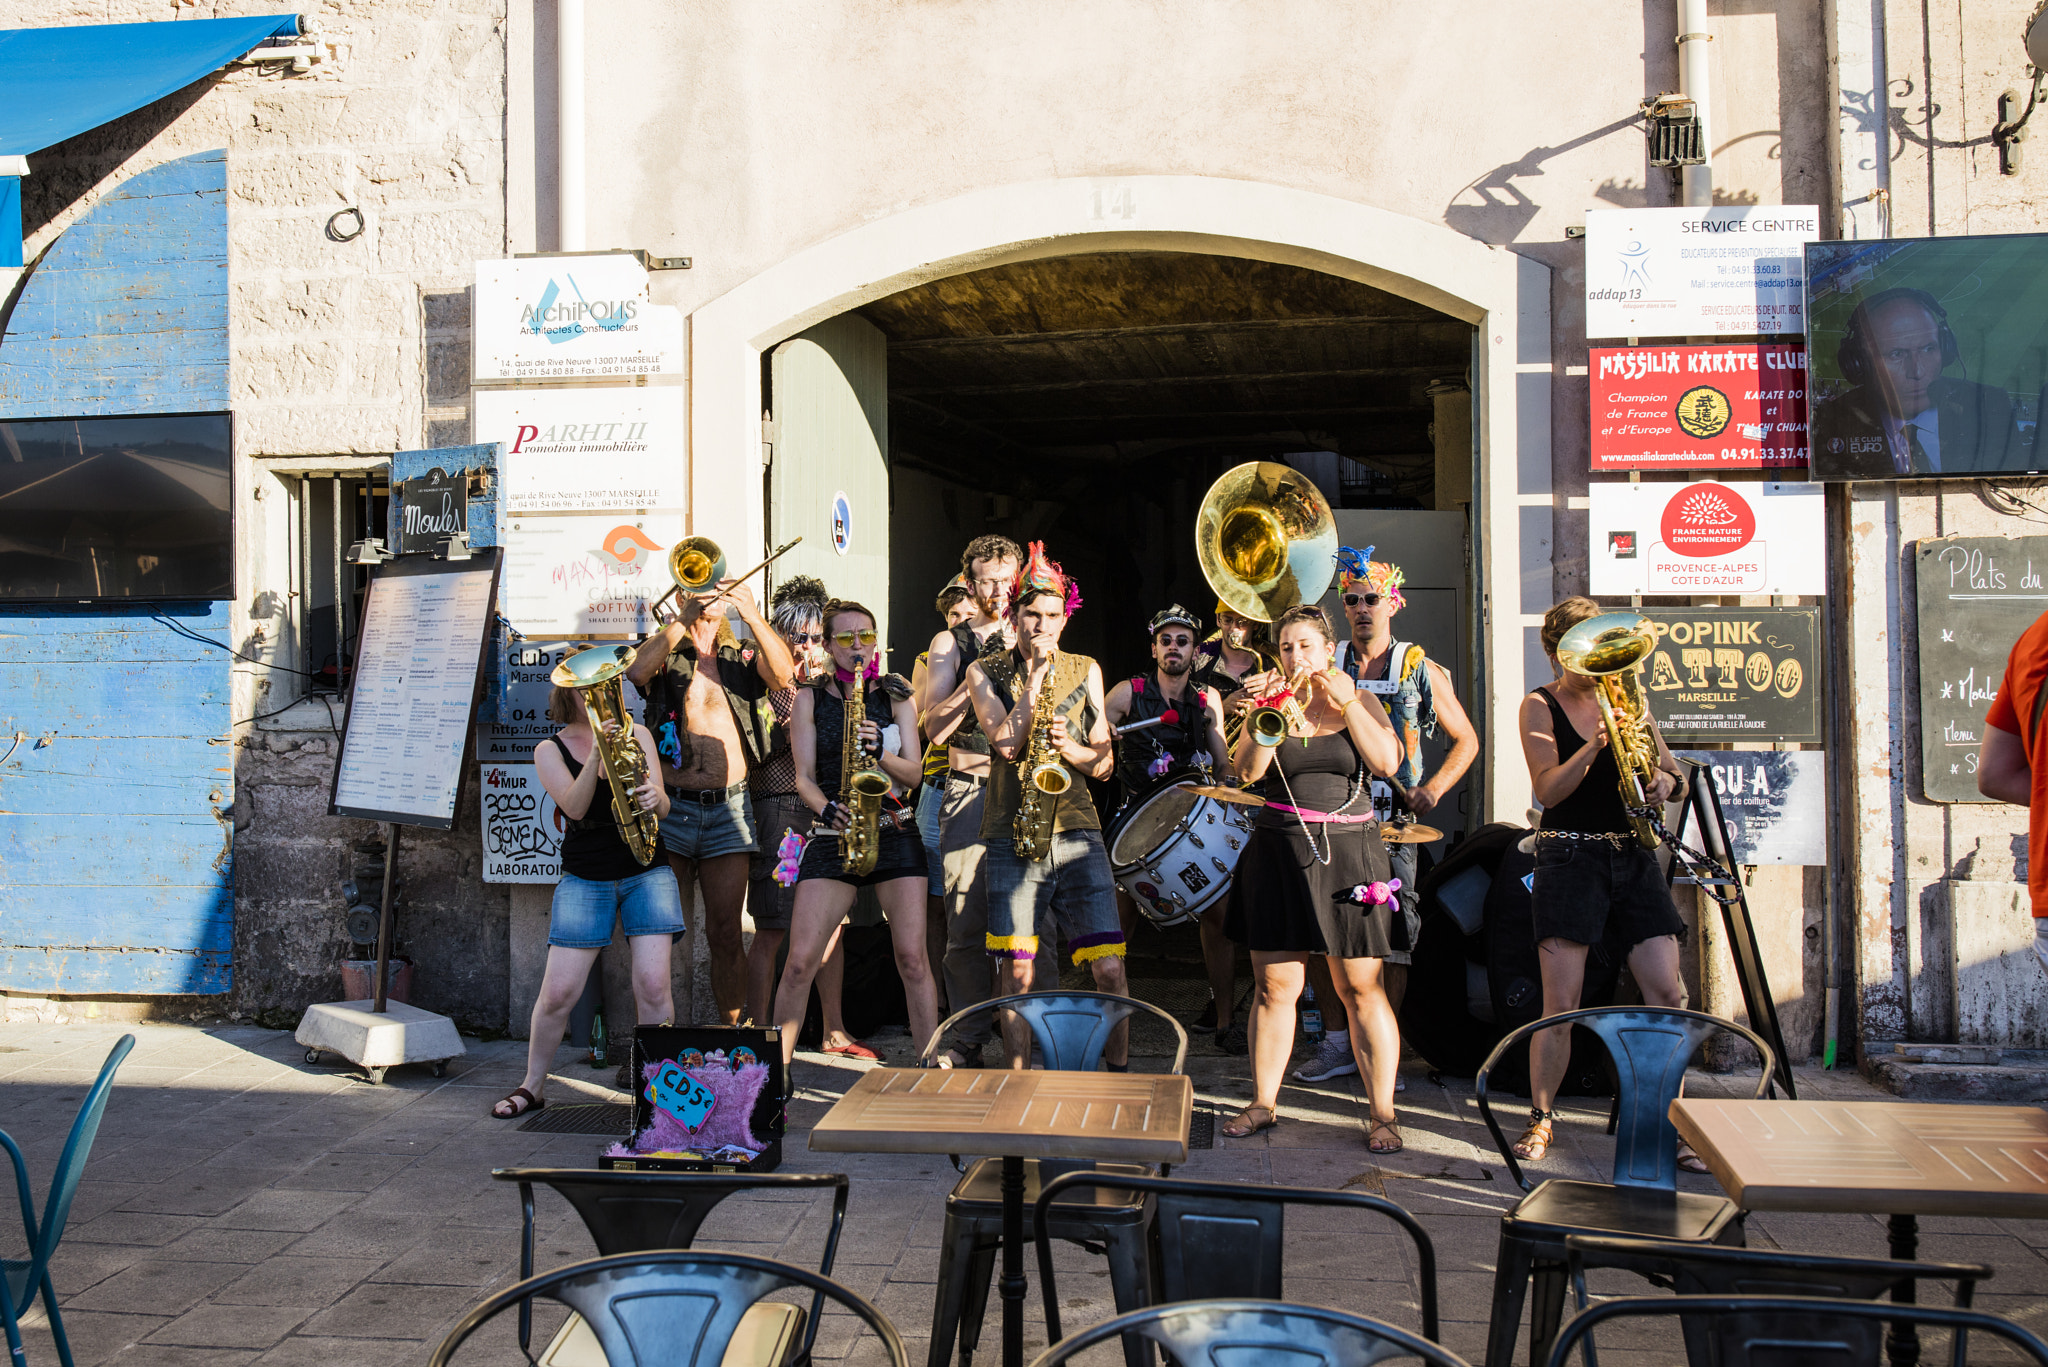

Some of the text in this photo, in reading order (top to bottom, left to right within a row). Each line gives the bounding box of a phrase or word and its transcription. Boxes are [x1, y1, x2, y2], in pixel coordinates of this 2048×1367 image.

[1090, 187, 1136, 220] 14
[1682, 219, 1814, 233] SERVICE CENTRE
[1681, 248, 1719, 258] EDUCATEURS
[1719, 248, 1727, 258] DE
[1732, 265, 1781, 274] 04.91.33.60.83
[1691, 279, 1705, 288] Mail
[521, 300, 637, 322] ArchiPOLIS
[1701, 305, 1724, 316] SERVICE
[1724, 305, 1762, 316] EDUCATEURS
[1762, 305, 1771, 315] DE
[520, 323, 639, 335] Architectes Constructeurs
[515, 359, 532, 369] quai
[535, 359, 545, 367] de
[547, 358, 564, 366] Rive
[566, 357, 591, 366] Neuve
[594, 357, 618, 365] 13007
[620, 355, 660, 364] MARSEILLE
[1599, 350, 1806, 380] MASSILIA KARATE CLUB
[516, 368, 526, 376] 04
[528, 368, 537, 376] 91
[540, 368, 550, 376] 54
[552, 367, 562, 375] 80
[564, 367, 575, 375] 88
[601, 366, 612, 374] 04
[626, 365, 636, 373] 54
[638, 365, 649, 373] 85
[650, 365, 661, 373] 48
[1608, 392, 1668, 404] Champion
[1744, 389, 1803, 400] KARATE DO
[1606, 409, 1668, 419] de France
[1766, 406, 1777, 415] et
[1601, 424, 1673, 436] et d'Europe
[508, 423, 623, 454] PARHT
[579, 441, 648, 453] immobilière
[1850, 442, 1883, 453] EURO
[1601, 450, 1715, 461] www.massiliakarateclub.com
[510, 489, 660, 500] quai de Rive Neuve 13007 MARSEILLE
[529, 500, 538, 508] 91
[540, 500, 550, 508] 54
[551, 500, 561, 508] 06
[562, 500, 572, 508] 96
[581, 499, 595, 507] Fax
[601, 499, 611, 507] 04
[646, 498, 657, 506] 48
[405, 492, 461, 536] Moules
[1657, 563, 1758, 573] PROVENCE-ALPES
[1938, 546, 2044, 590] Plats du
[1671, 576, 1744, 585] COTE D'AZUR
[588, 586, 662, 600] CALINDA
[588, 602, 657, 613] SOFTWAR
[509, 648, 550, 667] club
[1637, 648, 1803, 698] ATTOO
[1678, 692, 1737, 702] MARSEILLE
[512, 709, 537, 721] 04
[1744, 721, 1767, 729] GAUCHE
[1944, 720, 1976, 741] Menu
[490, 743, 507, 753] Au
[501, 777, 527, 788] MUR
[1733, 796, 1742, 805] de
[1743, 796, 1770, 805] coiffure
[664, 1070, 690, 1095] CD
